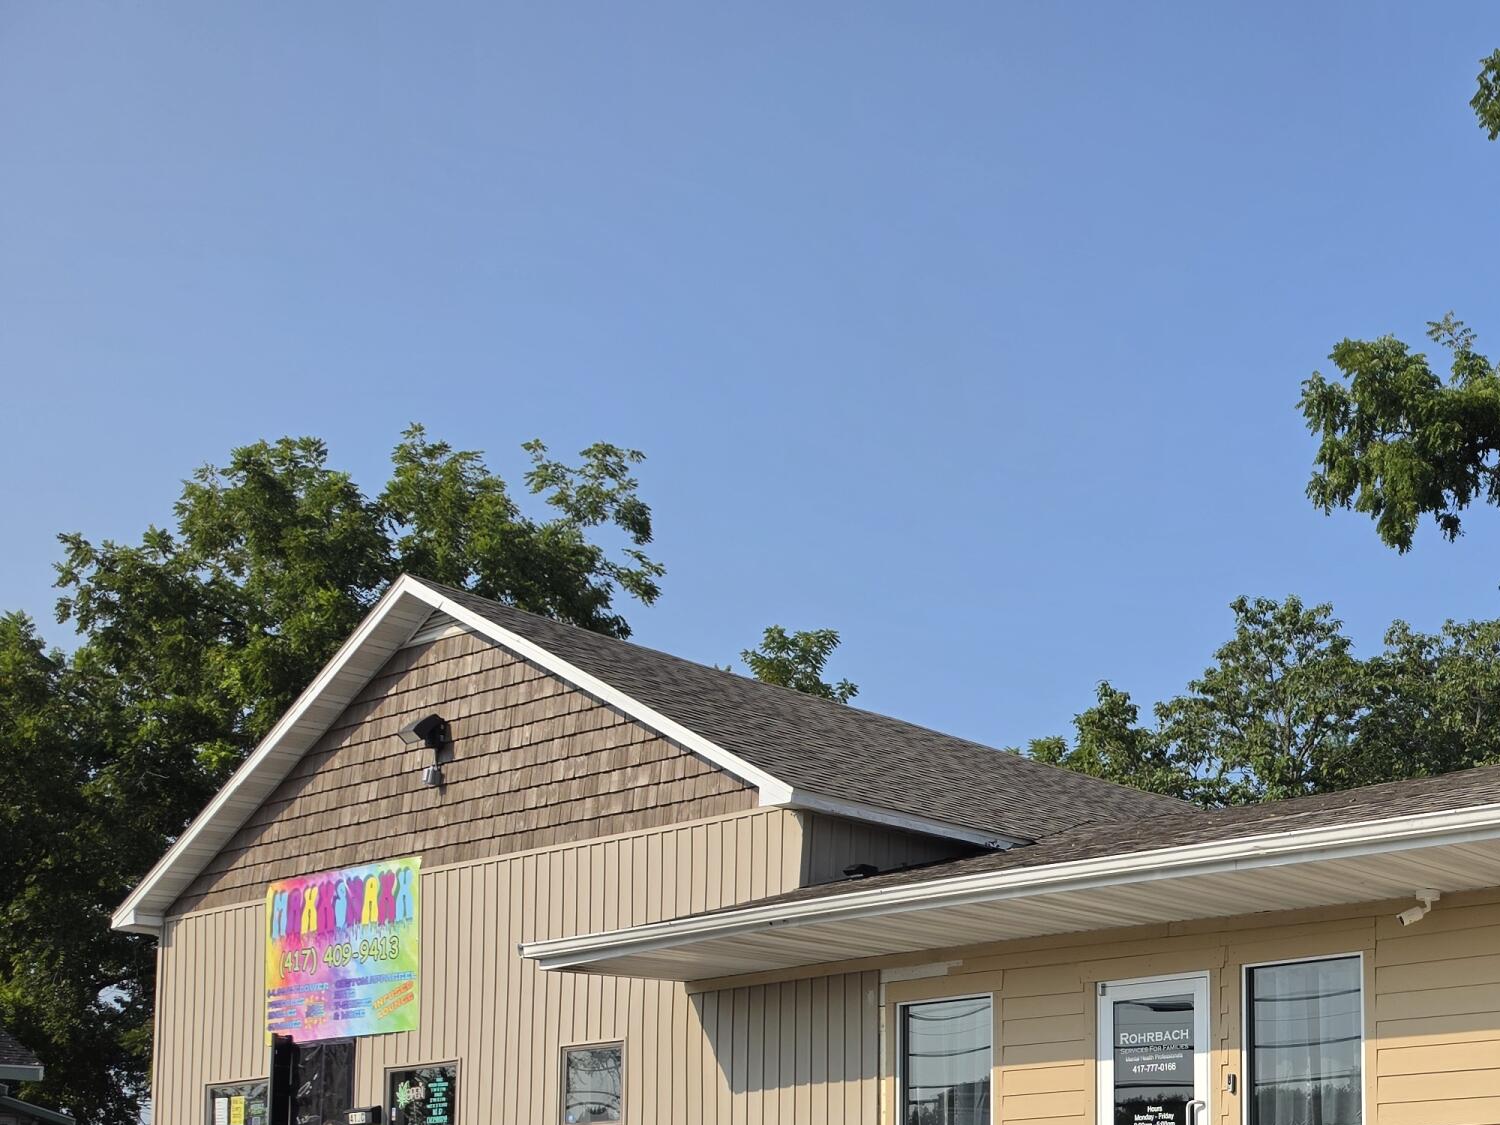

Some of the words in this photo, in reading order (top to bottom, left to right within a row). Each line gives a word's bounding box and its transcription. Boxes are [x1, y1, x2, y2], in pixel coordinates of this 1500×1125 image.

[280, 946, 317, 979] (417)
[323, 935, 400, 968] 409-9413
[1120, 1029, 1189, 1045] ROHRBACH
[1158, 1112, 1175, 1120] Friday
